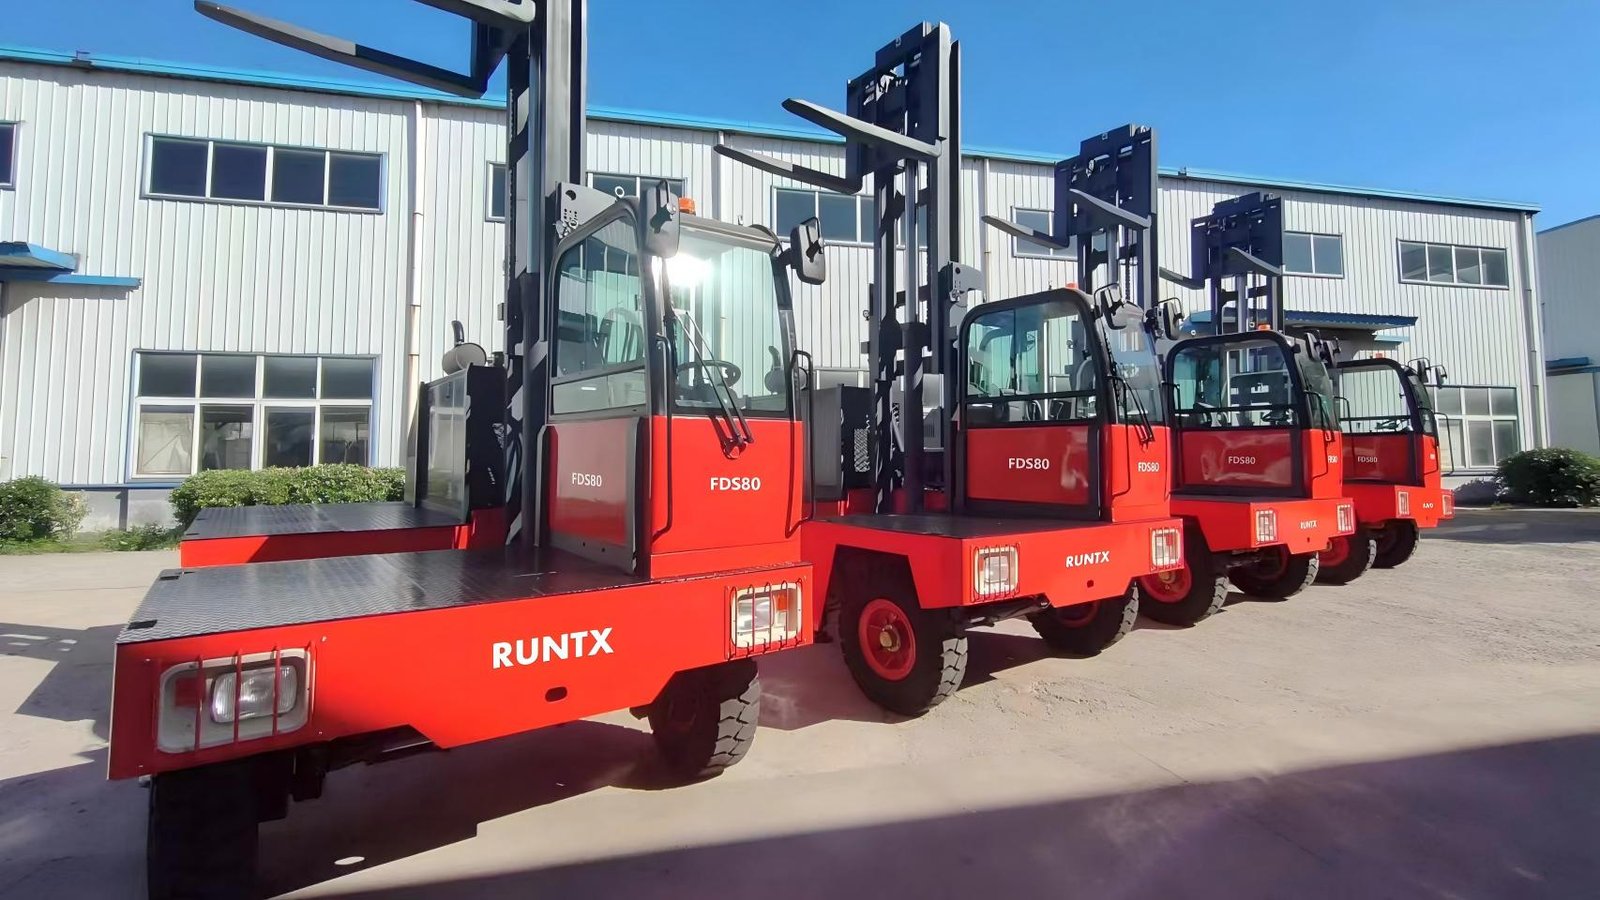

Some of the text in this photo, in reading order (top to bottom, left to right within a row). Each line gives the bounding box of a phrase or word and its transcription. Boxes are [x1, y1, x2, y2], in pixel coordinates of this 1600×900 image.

[1008, 457, 1050, 470] FDS80
[1137, 462, 1160, 472] FDS80
[1227, 456, 1256, 465] FDS80
[571, 472, 602, 487] FDS80
[710, 476, 761, 491] FDS80
[1065, 550, 1110, 568] RUNTX
[492, 627, 614, 669] RUNTX
